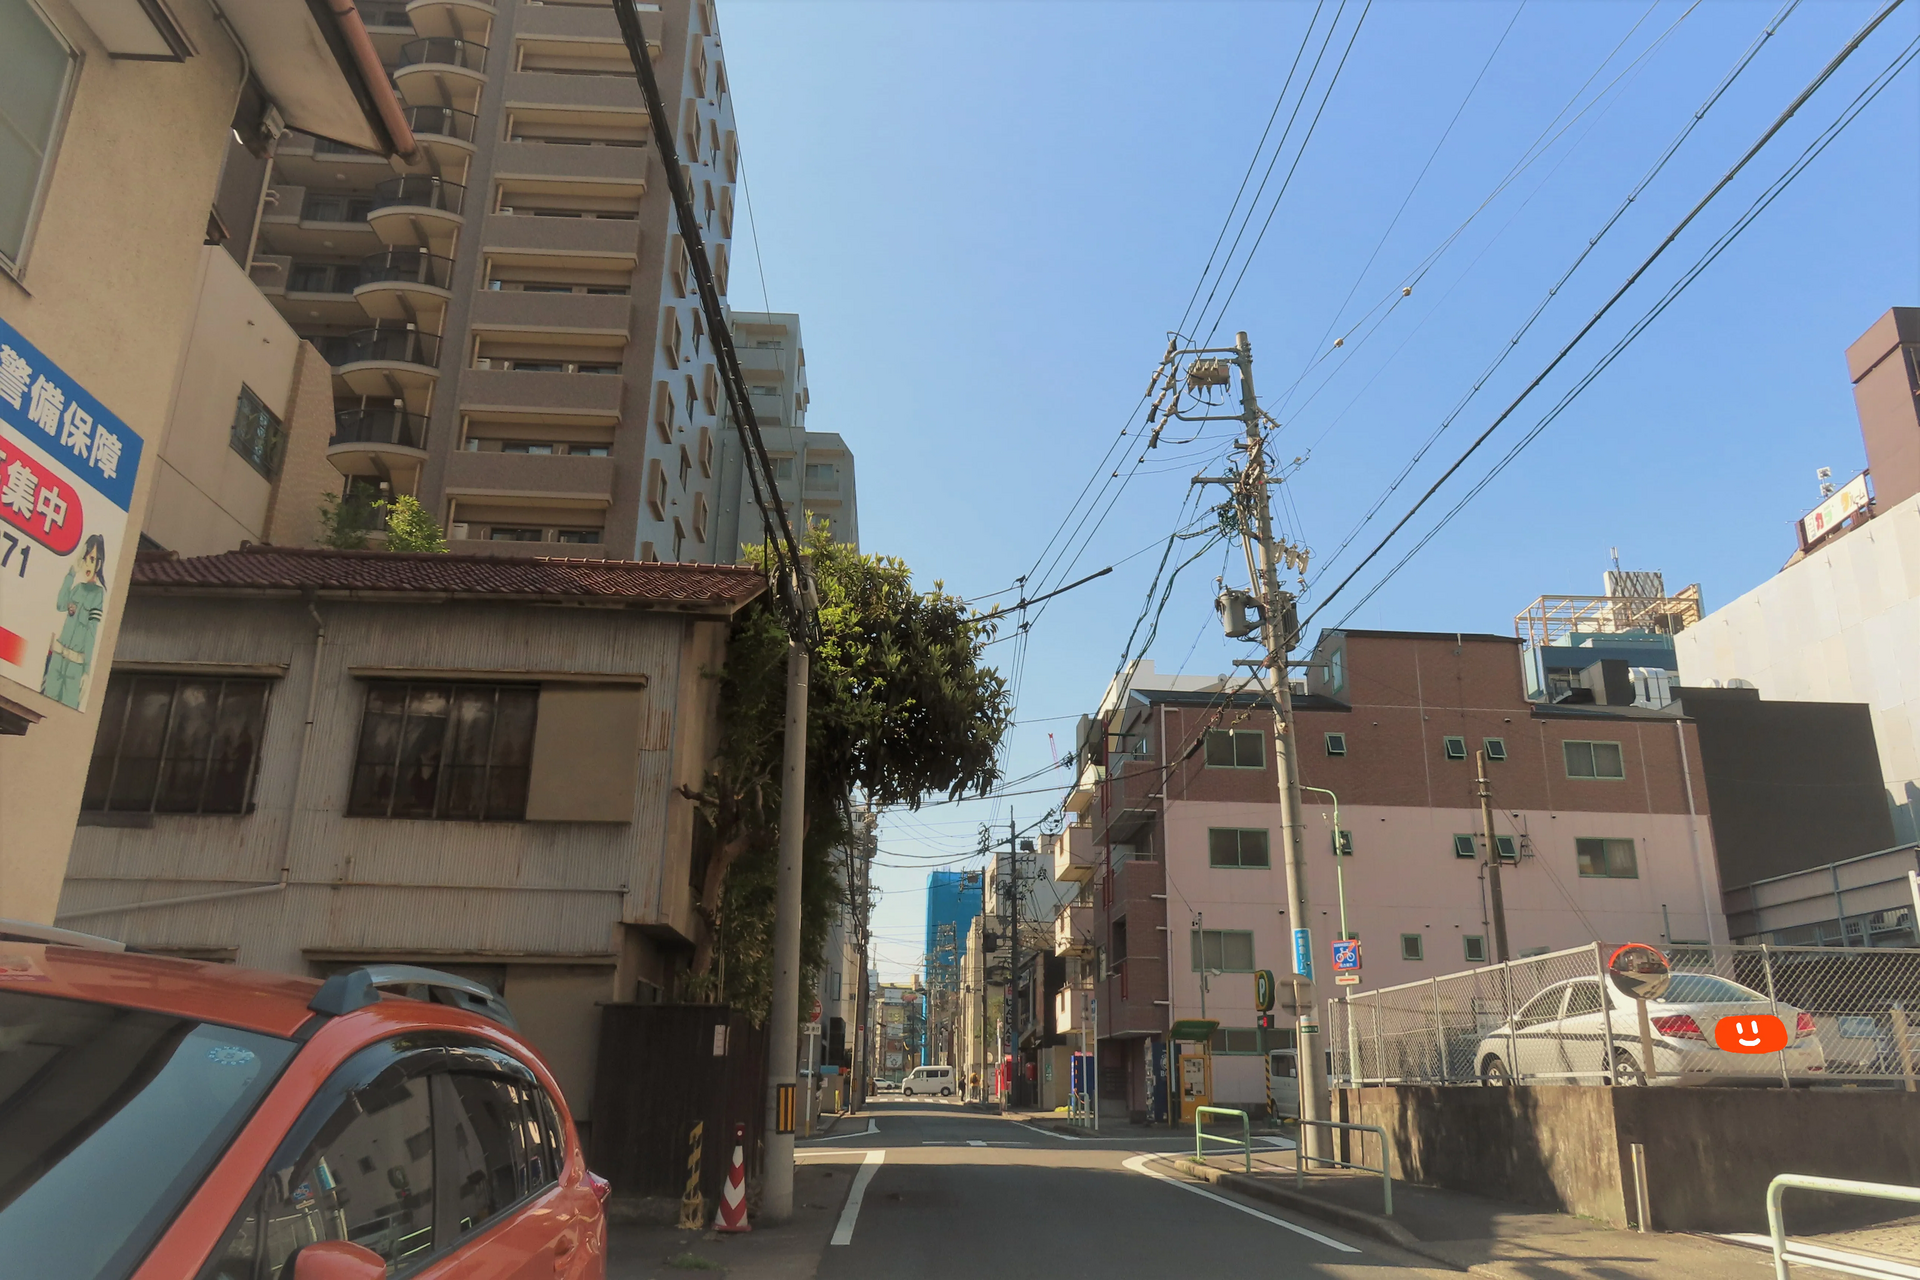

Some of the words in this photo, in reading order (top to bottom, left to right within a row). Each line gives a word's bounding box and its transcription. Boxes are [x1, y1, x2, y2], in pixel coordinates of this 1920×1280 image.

[0, 343, 123, 482] 警備保障
[0, 455, 68, 534] 集中
[0, 530, 31, 578] 71
[1258, 978, 1266, 1003] P
